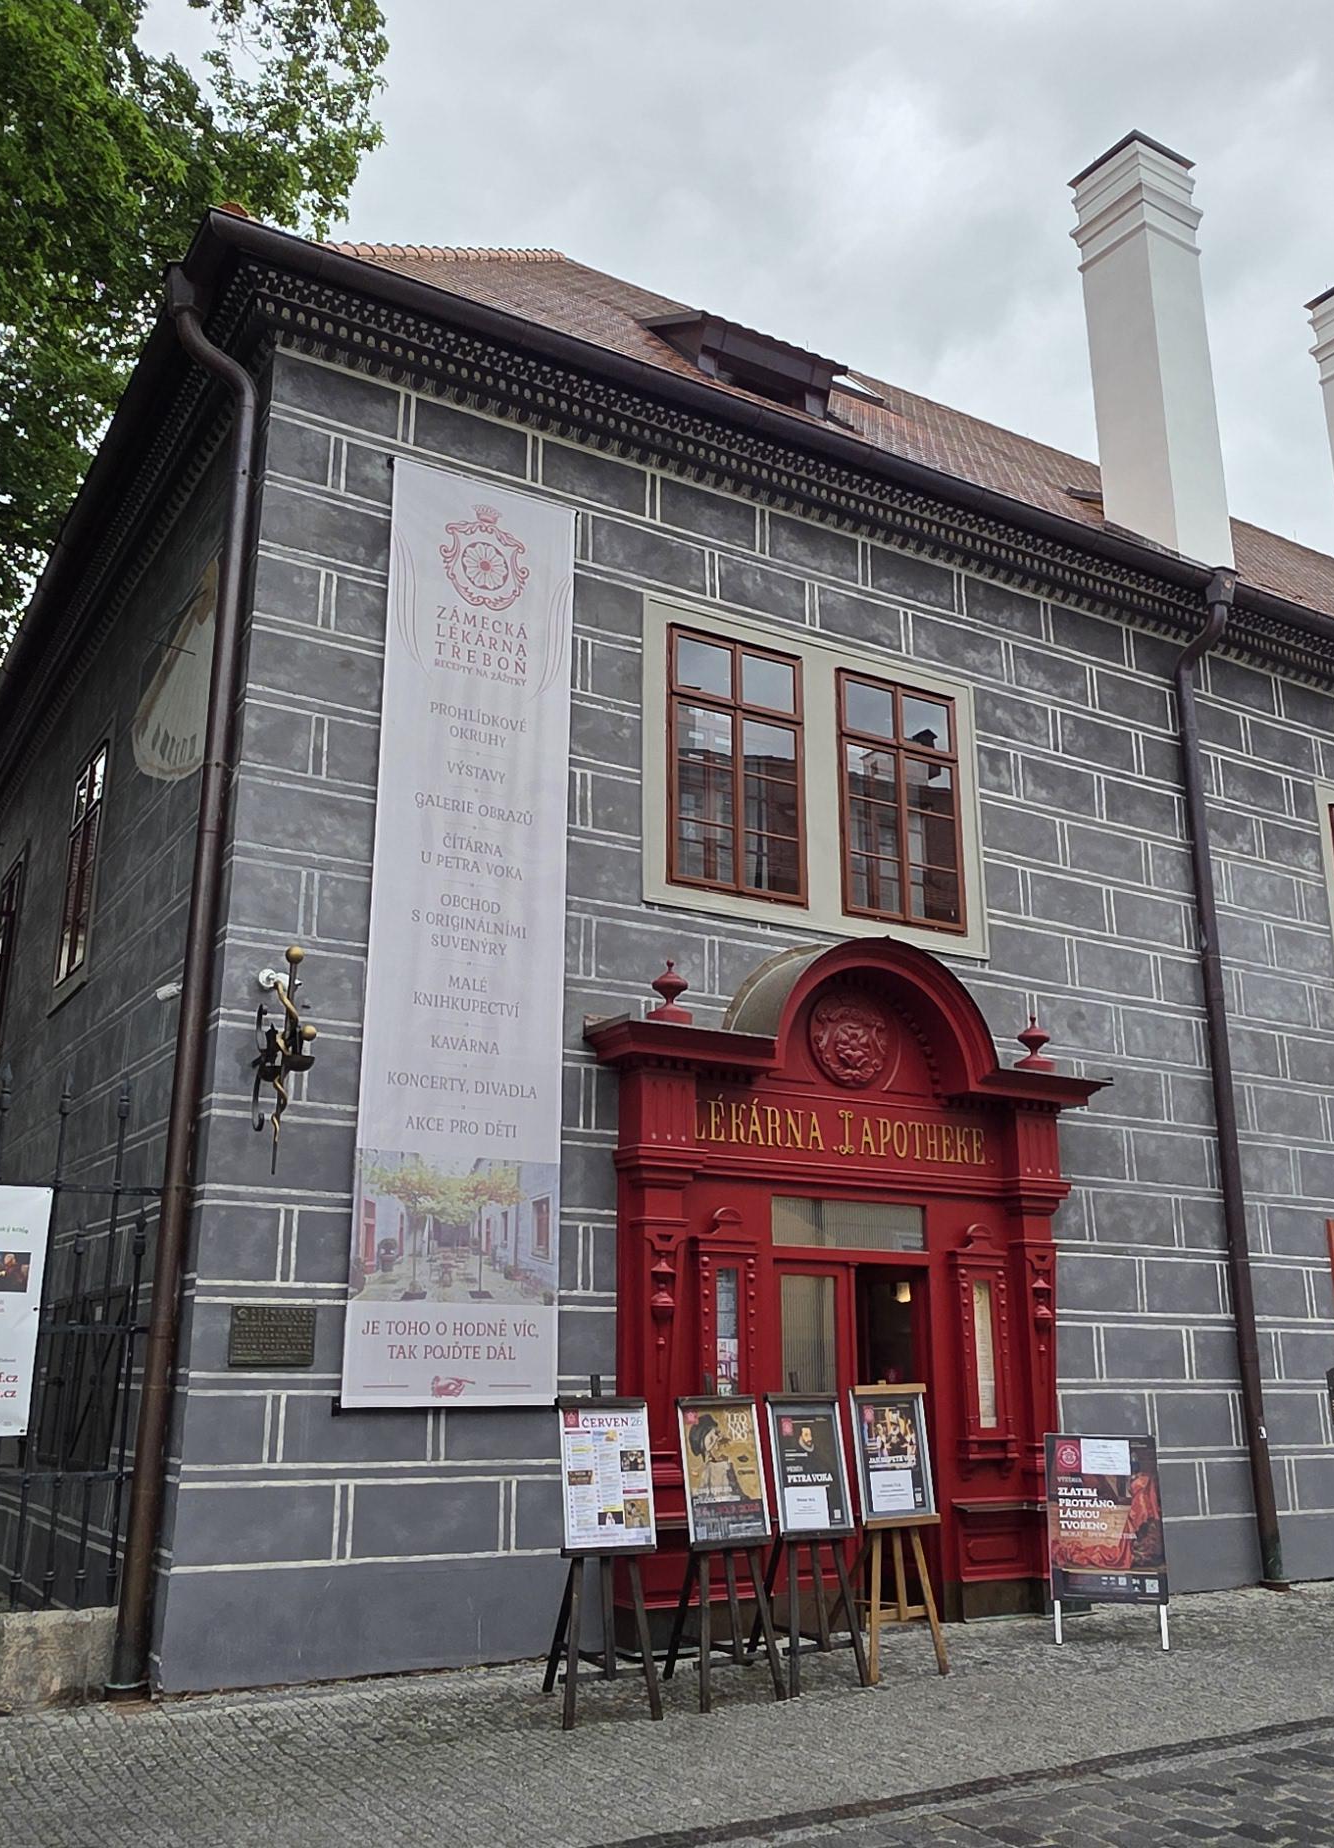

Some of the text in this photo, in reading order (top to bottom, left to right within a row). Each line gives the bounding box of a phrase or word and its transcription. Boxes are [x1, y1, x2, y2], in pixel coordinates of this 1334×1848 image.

[436, 605, 527, 640] ZÁMECKÁ
[436, 623, 527, 657] LÉKÁRNA
[435, 641, 526, 674] TŘEBOŇ
[475, 666, 488, 679] NA
[430, 701, 527, 733] PROHLÍDKOVÉ
[449, 725, 507, 748] OKRUHY
[447, 759, 506, 784] VÝSTAVY
[415, 792, 534, 826] GALERIE OBRAZŮ
[443, 832, 503, 858] ČÍTÁRNA
[421, 851, 523, 881] U PETRA VOKA
[440, 893, 501, 914] OBCHOD
[411, 909, 527, 939] S ORIGINÁLNÍMI
[431, 933, 508, 956] SUVENÝRY
[448, 975, 488, 993] MALÉ
[413, 991, 520, 1018] KNIHKUPECTVÍ
[430, 1034, 500, 1055] KAVÁRNA
[386, 1071, 537, 1099] KONCERTY, DIVADLA
[405, 1115, 518, 1138] AKCE PRO DĚTI
[695, 1093, 826, 1151] LÉKÁRNA
[362, 1318, 539, 1339] JE TOHO O HODNĚ VÍC,
[387, 1341, 516, 1361] TAK POJĎTE DÁL
[581, 1416, 644, 1429] ČERVEN 26
[787, 1473, 834, 1483] PETRA VOKA
[1057, 1487, 1098, 1497] ZLATEM
[1058, 1498, 1116, 1509] PROTKÁNO,
[1059, 1508, 1100, 1519] LÁSKOU
[1059, 1520, 1108, 1531] TVOŘENO
